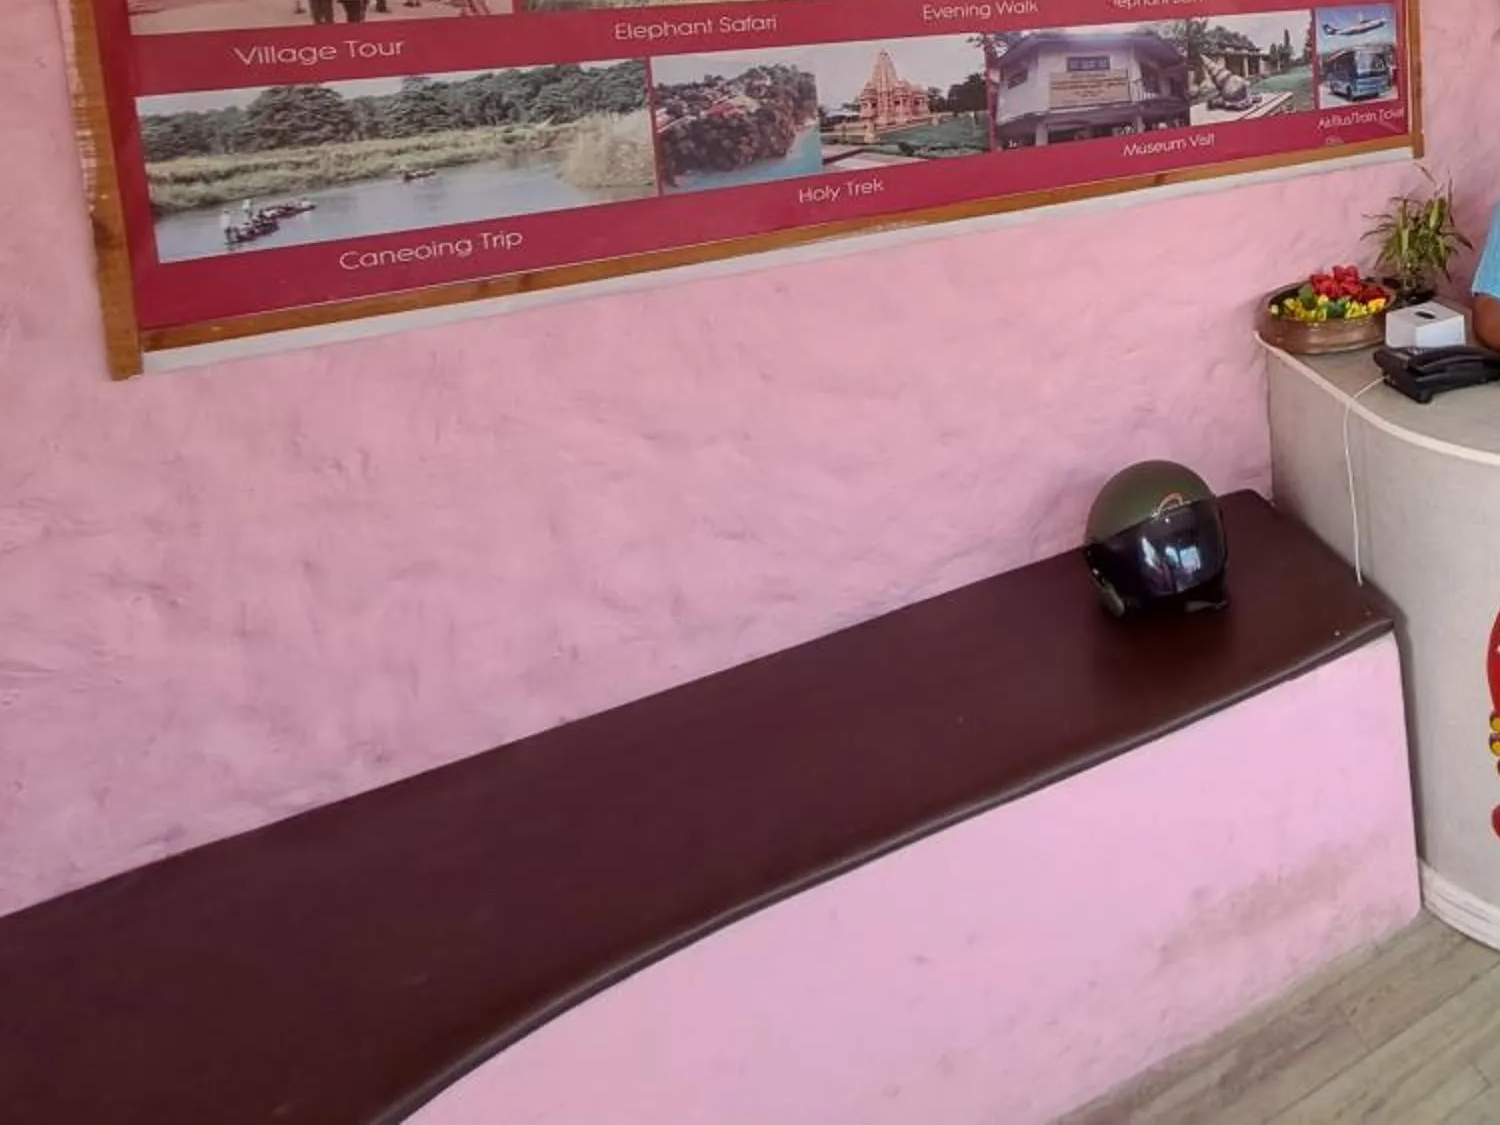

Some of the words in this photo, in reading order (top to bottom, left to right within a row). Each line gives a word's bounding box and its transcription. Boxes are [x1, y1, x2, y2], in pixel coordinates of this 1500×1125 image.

[923, 2, 990, 23] Evening
[995, 0, 1038, 16] Walk
[615, 18, 712, 41] Elephant
[719, 16, 777, 33] Safari
[233, 41, 337, 68] Village
[343, 39, 407, 60] Tour
[1123, 138, 1186, 156] Museum
[798, 183, 842, 205] Holy
[845, 178, 884, 196] Trek
[479, 228, 523, 254] Trip
